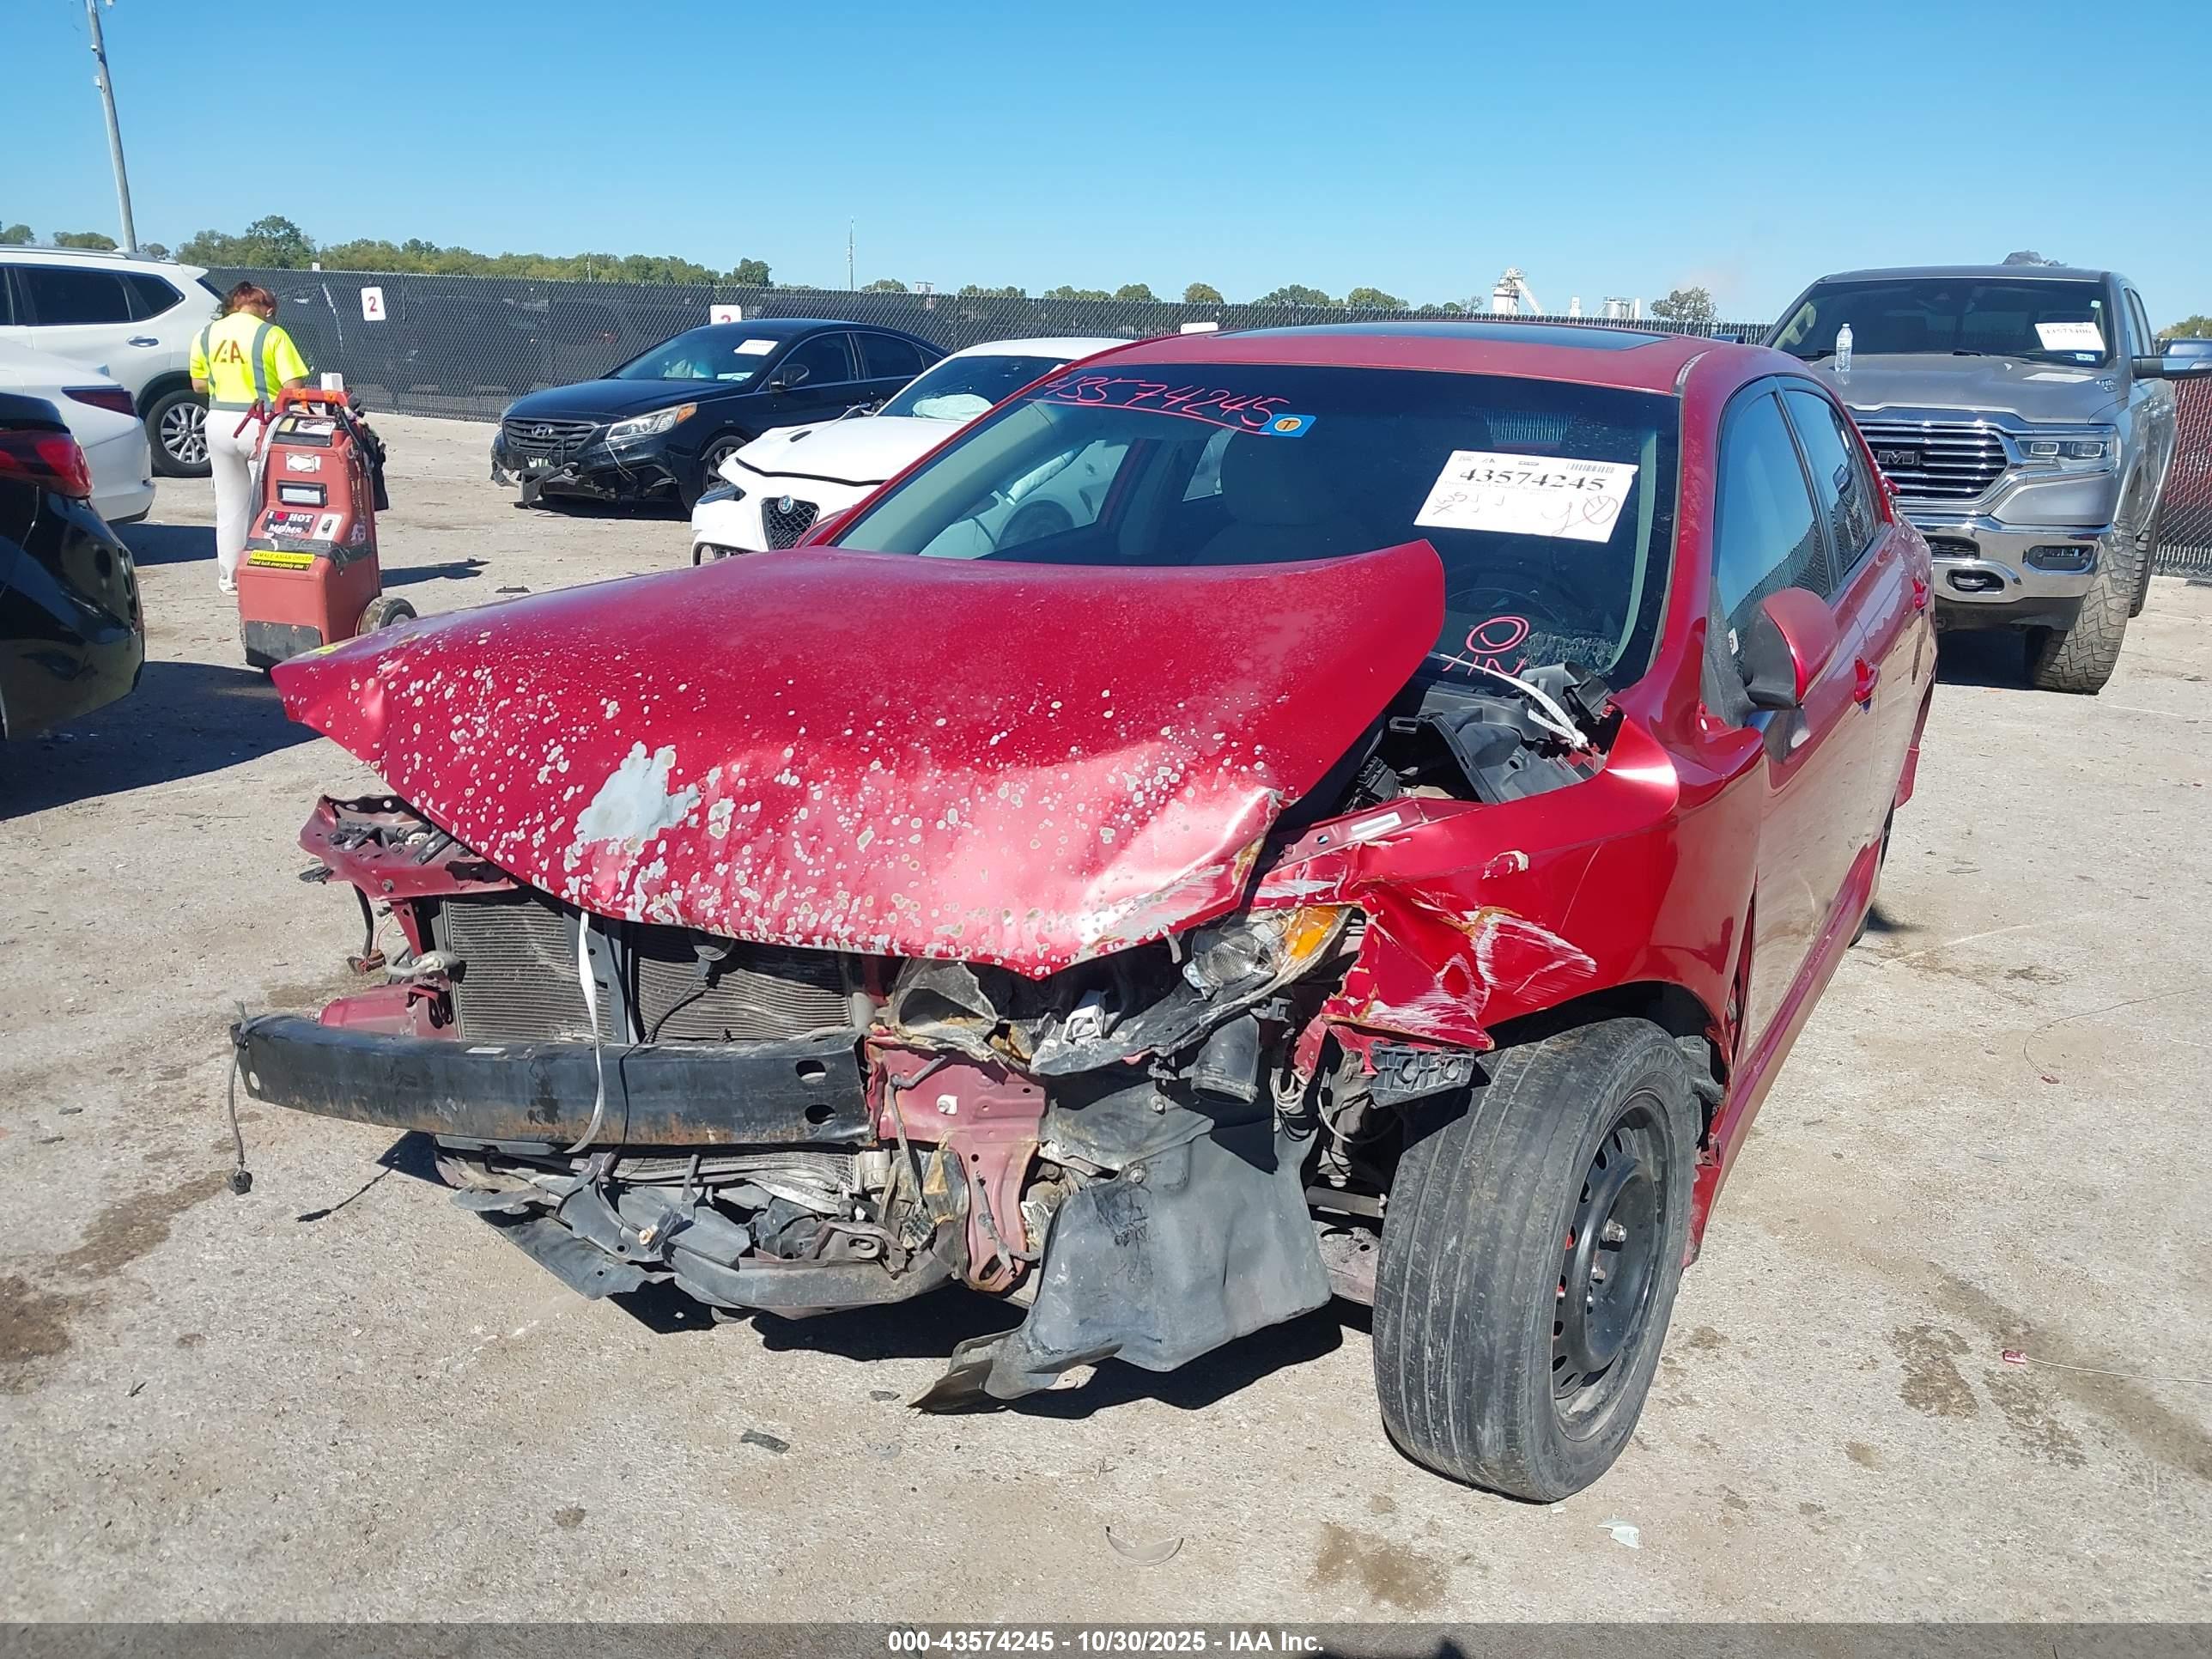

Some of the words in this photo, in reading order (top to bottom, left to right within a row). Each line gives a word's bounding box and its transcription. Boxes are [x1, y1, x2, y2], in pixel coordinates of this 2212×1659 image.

[368, 295, 378, 313] 2
[1043, 376, 1291, 427] 43574245
[1460, 468, 1607, 491] 43574245
[288, 513, 313, 523] HOT
